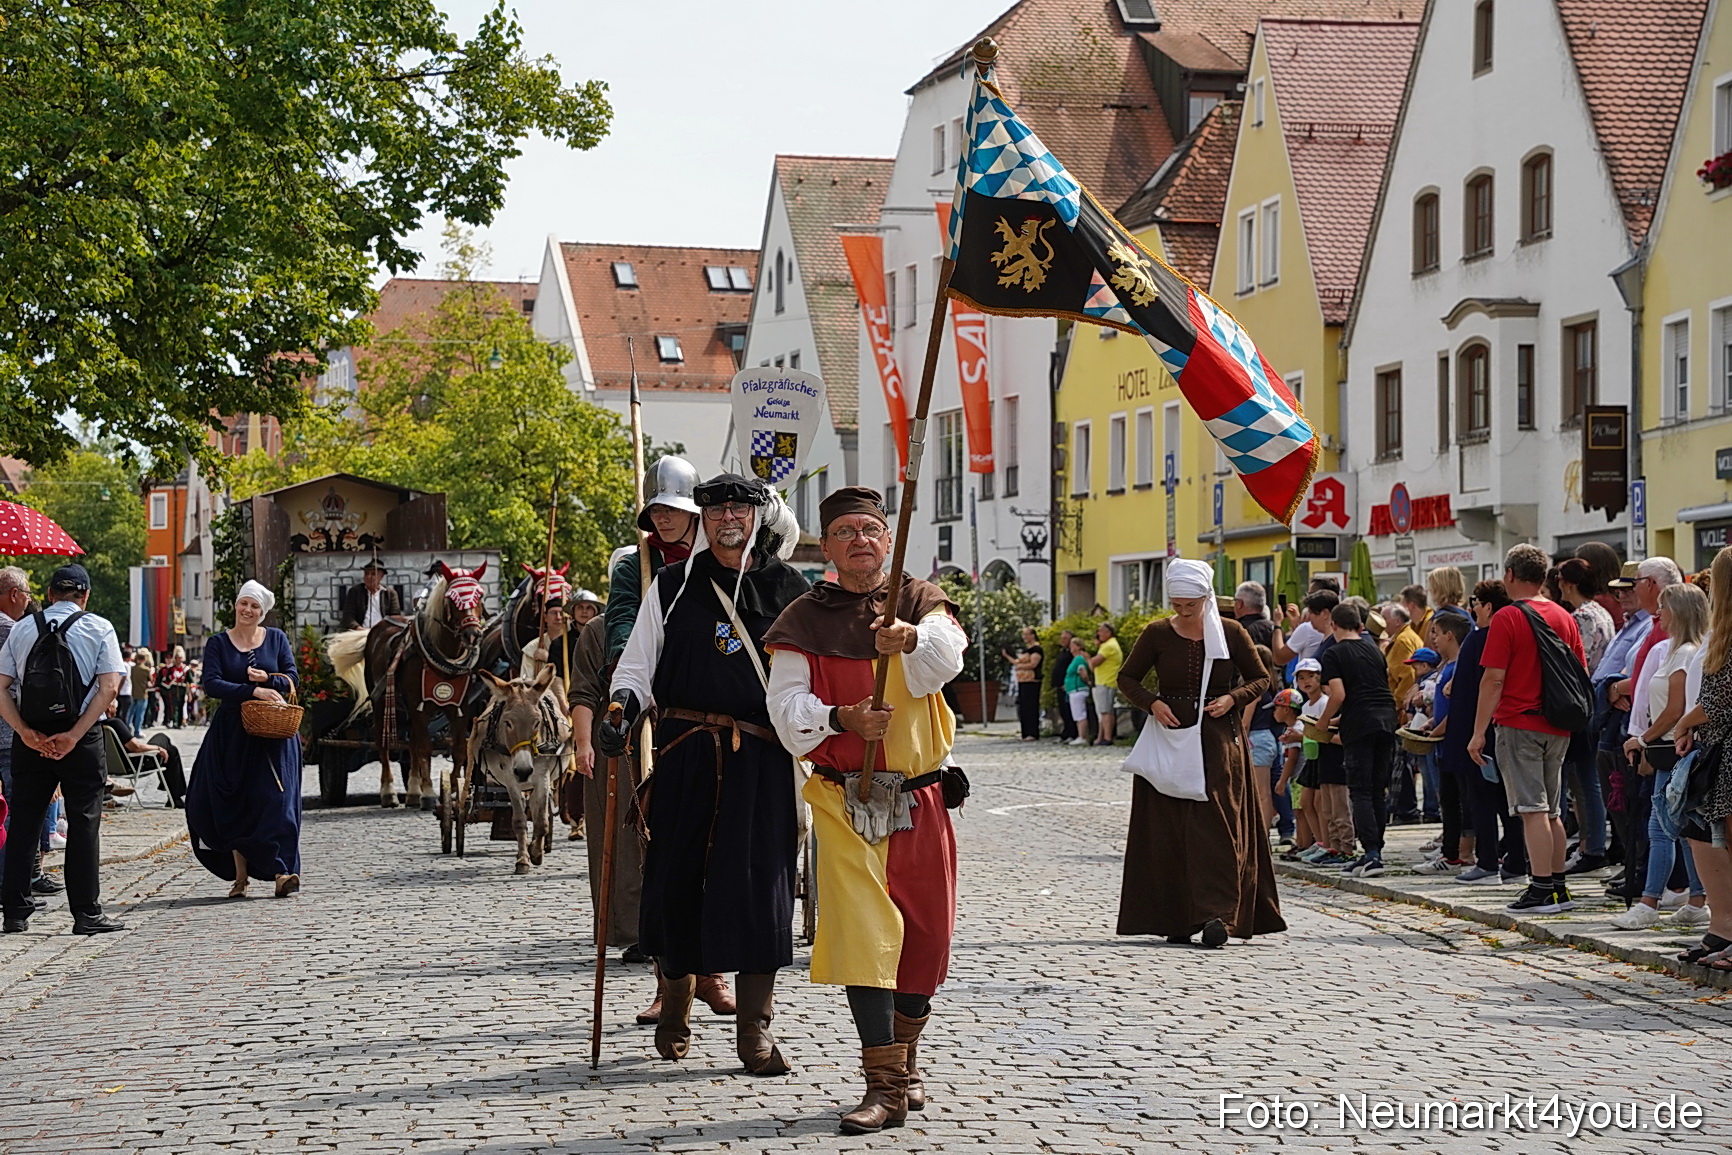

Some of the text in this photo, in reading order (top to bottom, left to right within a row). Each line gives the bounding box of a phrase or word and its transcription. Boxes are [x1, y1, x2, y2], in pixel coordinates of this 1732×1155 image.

[742, 378, 818, 398] Pfalzgräfisches
[1118, 367, 1150, 402] HOTEL
[753, 405, 800, 420] Neumarkt
[1700, 528, 1727, 547] WOLLE
